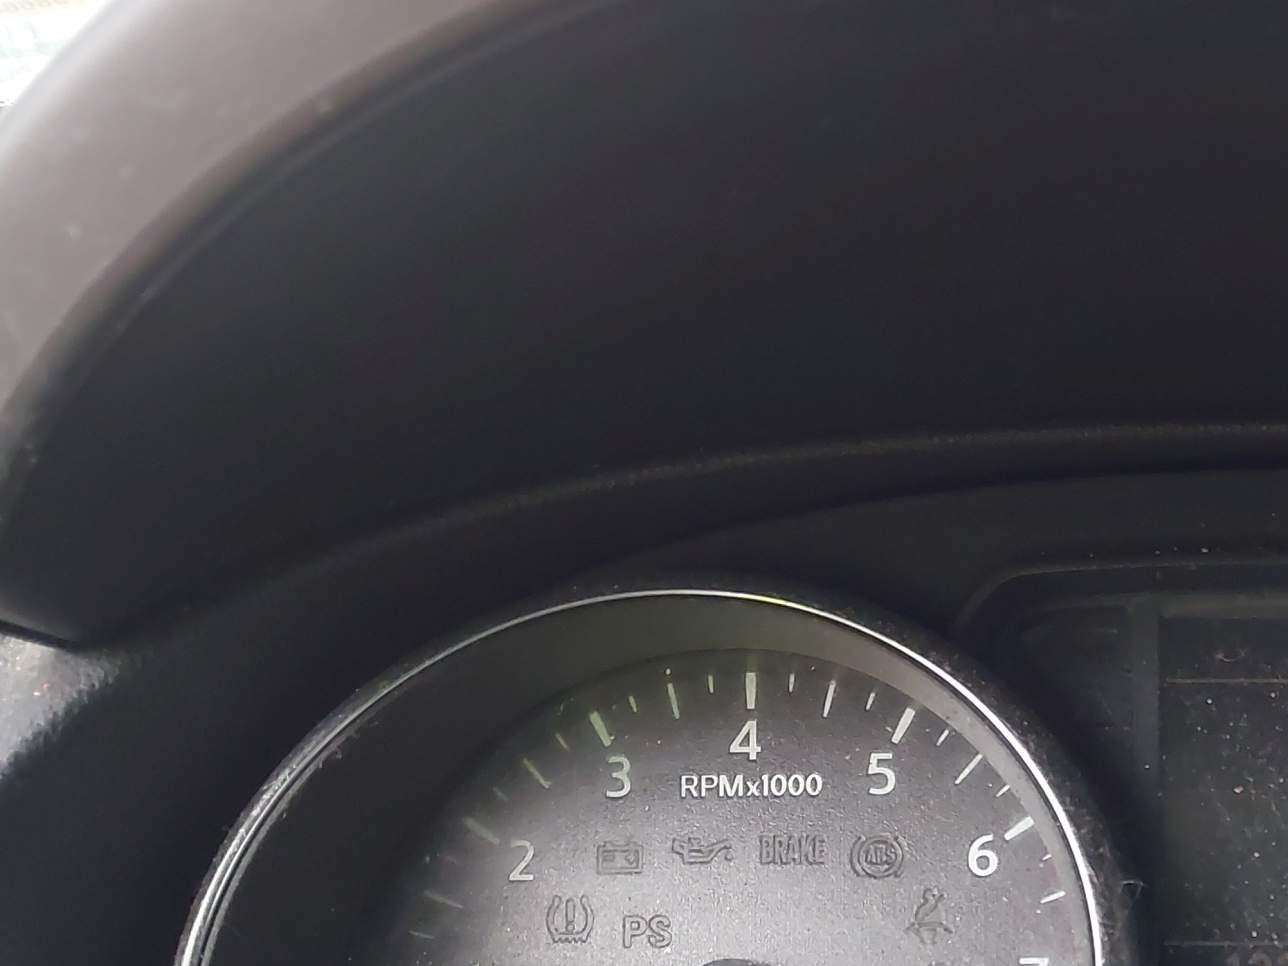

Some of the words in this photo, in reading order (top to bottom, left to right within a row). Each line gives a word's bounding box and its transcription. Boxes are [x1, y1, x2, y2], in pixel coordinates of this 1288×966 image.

[729, 720, 762, 761] 4
[605, 755, 632, 798] 3
[680, 774, 823, 798] RPMx1000
[867, 752, 896, 796] 5
[508, 840, 535, 881] 2
[759, 834, 826, 866] BRAKE
[967, 834, 998, 876] 6
[622, 914, 672, 949] PS
